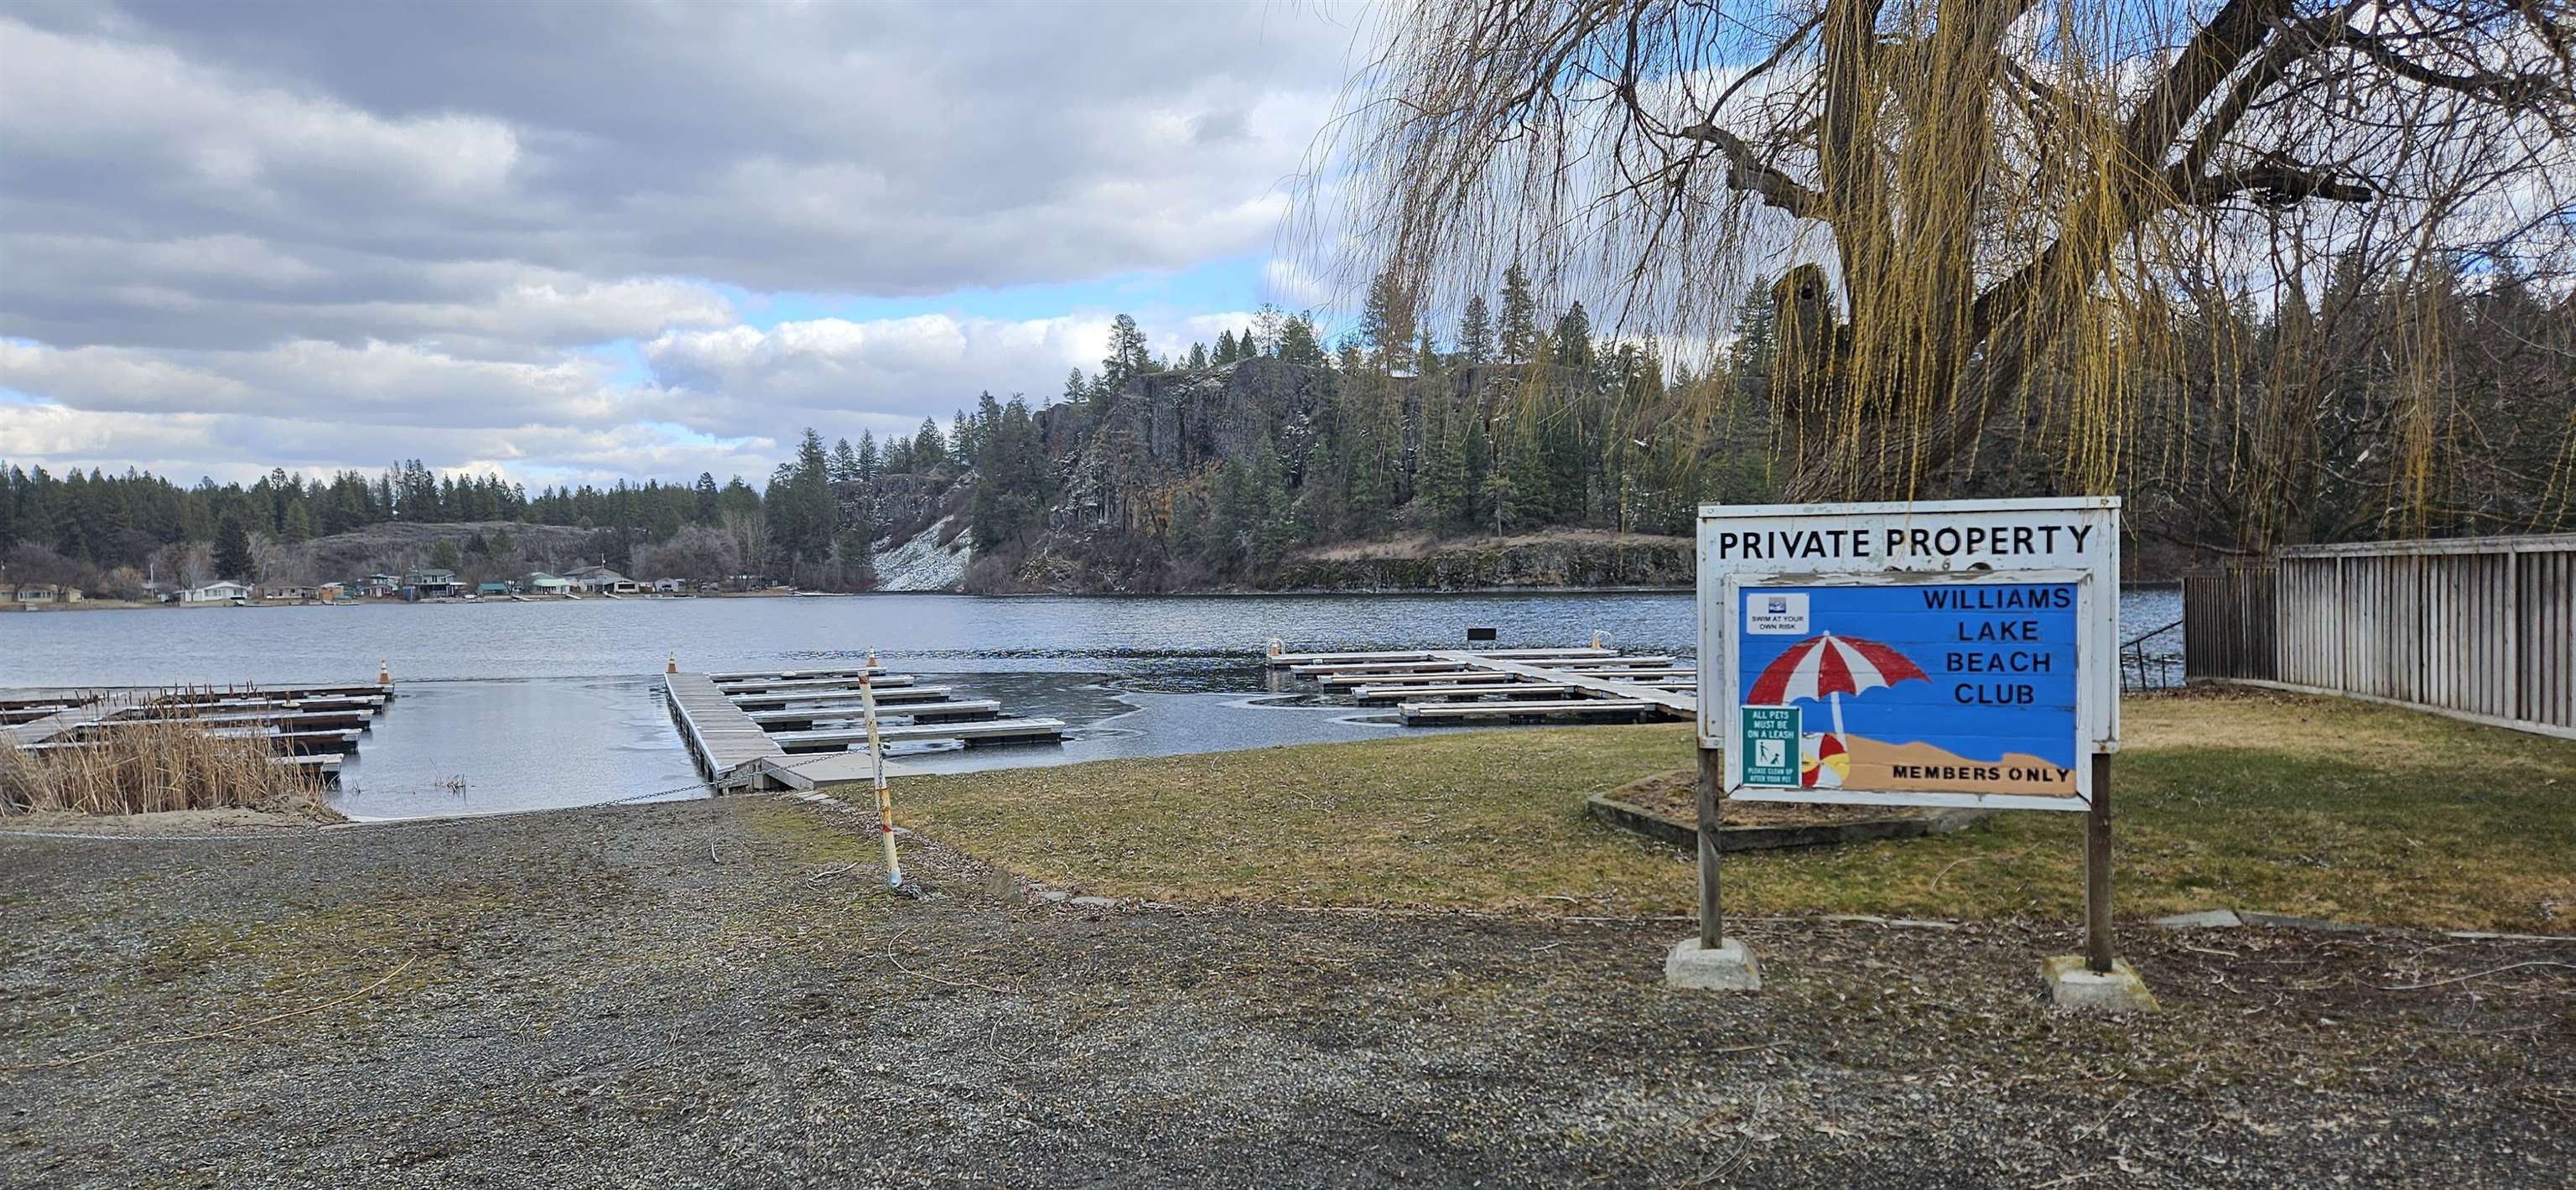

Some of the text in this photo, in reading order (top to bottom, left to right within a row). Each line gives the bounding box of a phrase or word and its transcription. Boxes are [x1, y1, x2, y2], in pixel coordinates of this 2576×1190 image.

[1720, 525, 2093, 559] PRIVATE PROPERTY
[1924, 588, 2071, 610] WILLIAMS
[1959, 621, 2038, 641] LAKE
[1947, 652, 2050, 672] BEACH
[1955, 683, 2034, 704] CLUB
[1893, 765, 2070, 783] MEMBERS ONLY
